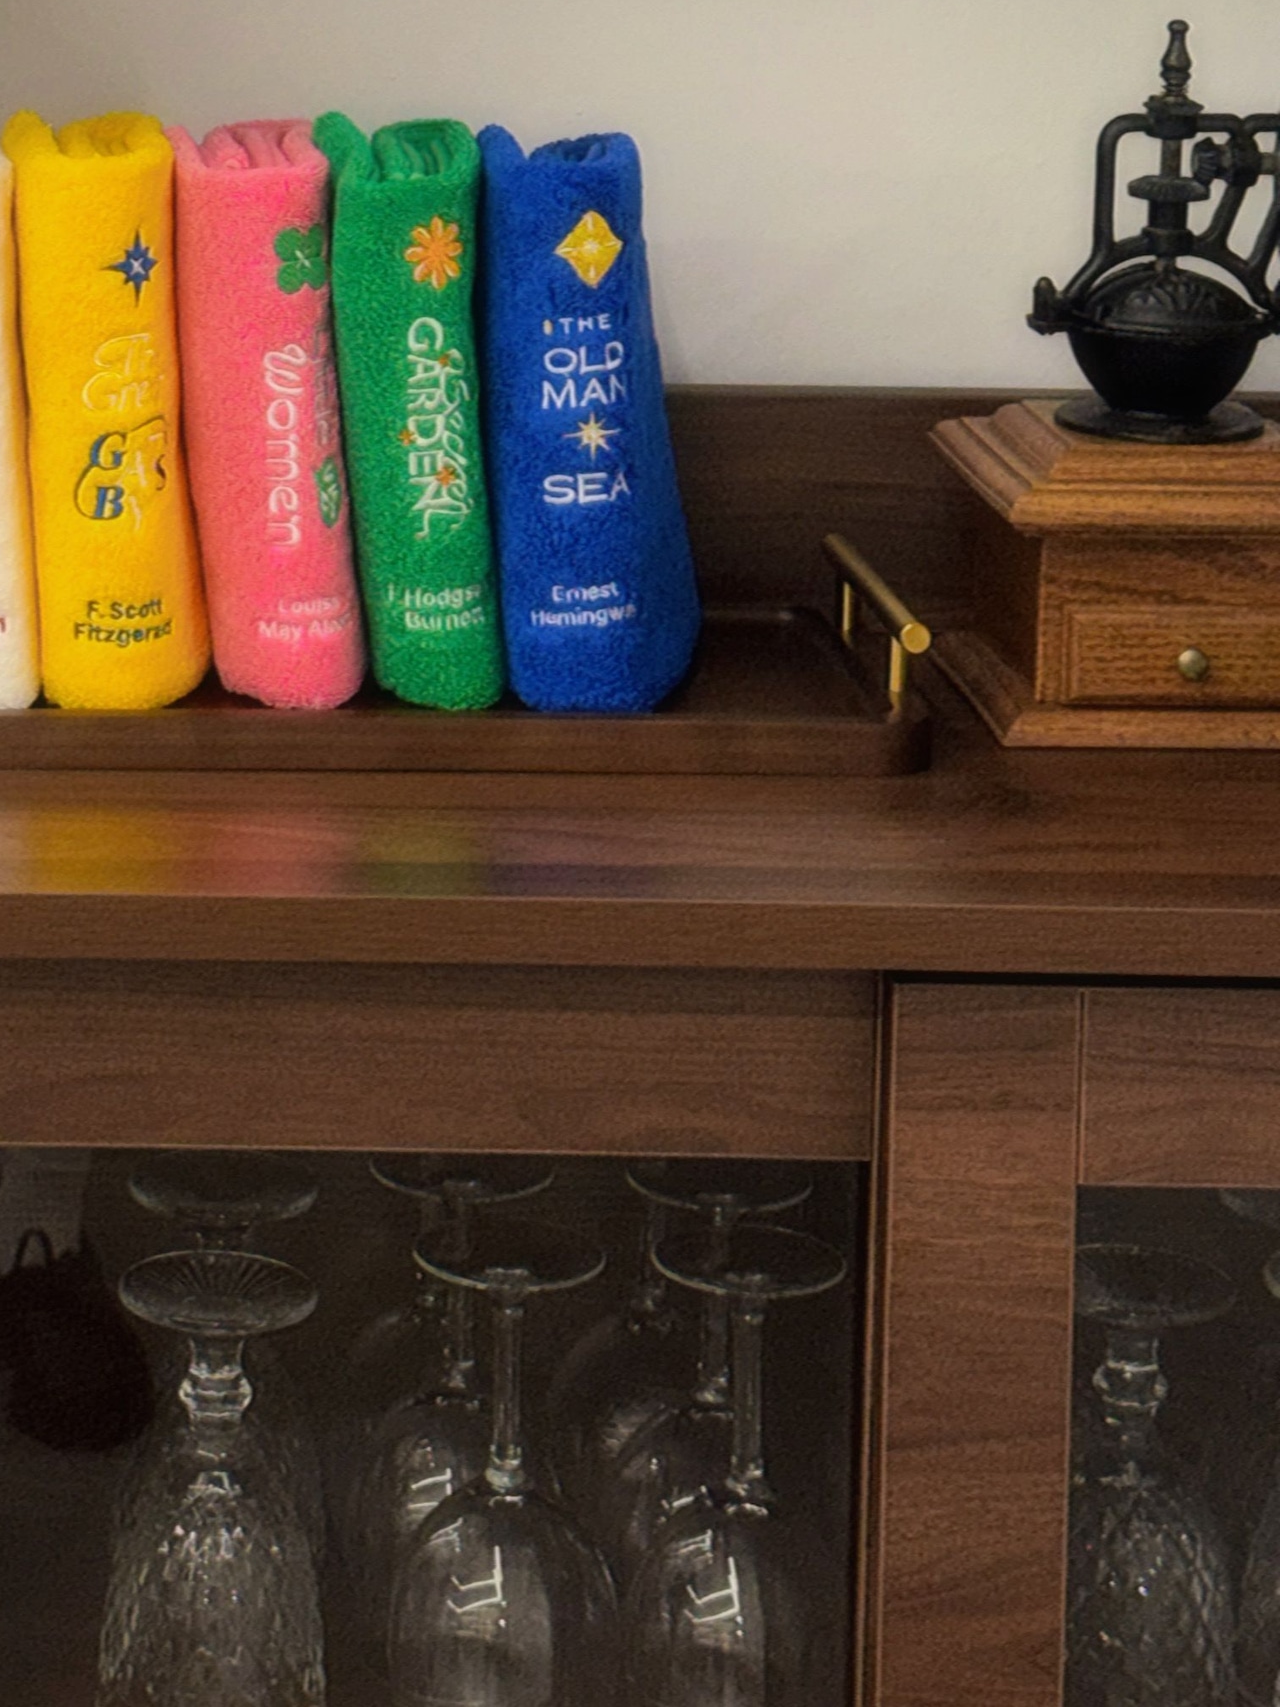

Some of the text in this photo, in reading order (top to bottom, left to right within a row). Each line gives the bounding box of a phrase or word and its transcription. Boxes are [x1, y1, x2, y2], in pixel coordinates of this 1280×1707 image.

[558, 313, 611, 335] THE
[543, 341, 625, 375] OLD
[541, 374, 627, 410] MAN
[407, 317, 445, 511] GARDEN
[263, 343, 309, 547] Women
[542, 470, 632, 505] SEA
[110, 598, 162, 620] Scott
